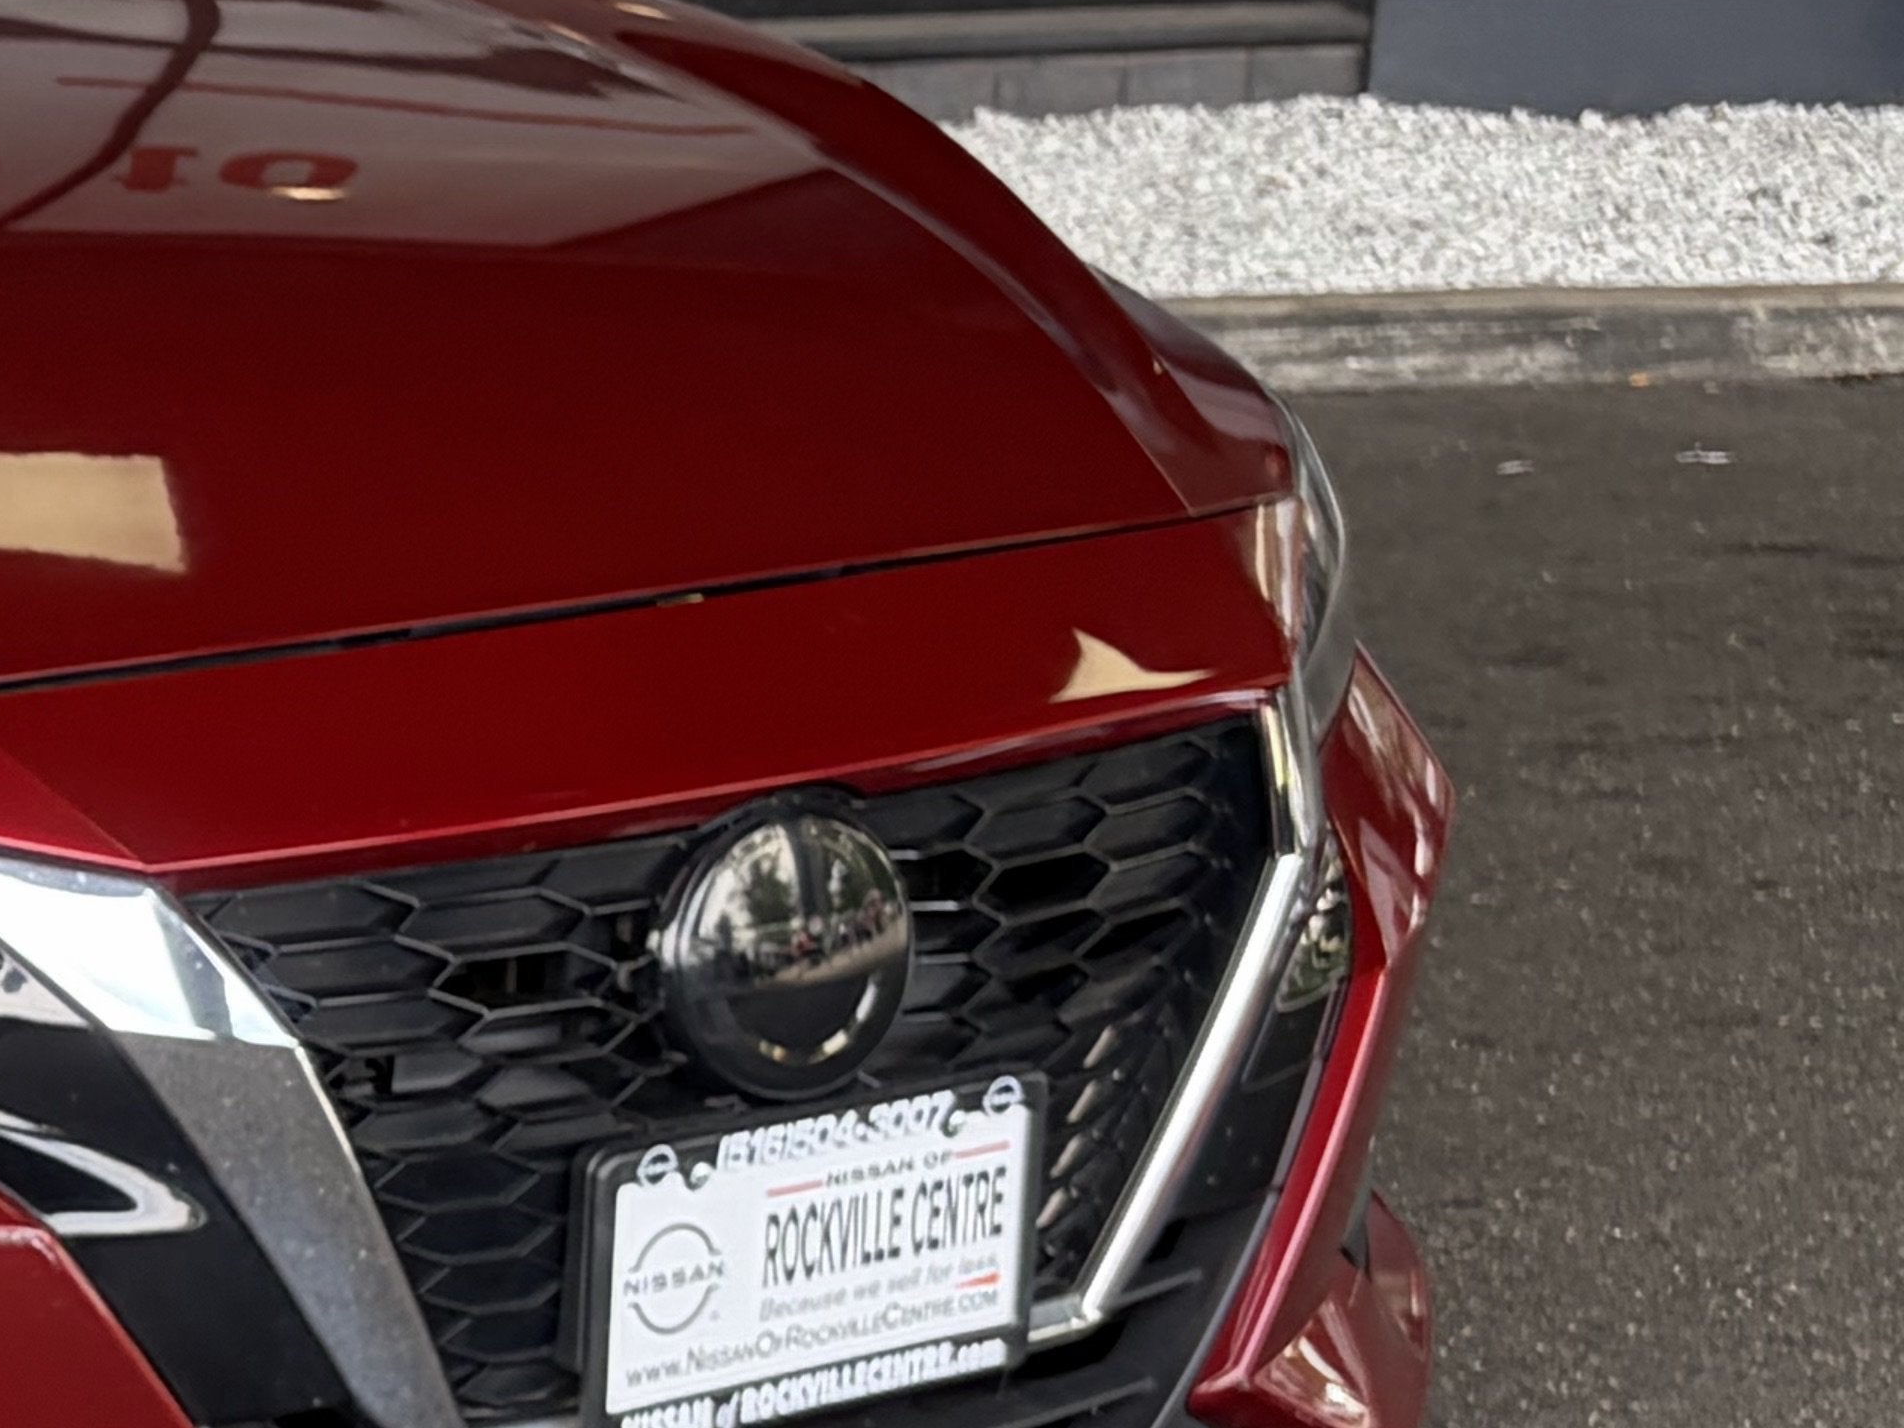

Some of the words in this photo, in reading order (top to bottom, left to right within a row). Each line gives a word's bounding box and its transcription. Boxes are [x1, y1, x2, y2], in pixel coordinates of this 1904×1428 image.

[825, 1151, 916, 1188] NISSAN
[763, 1186, 904, 1289] ROCKVILLE
[911, 1166, 1007, 1254] CENTRE
[623, 1260, 725, 1297] NISSAN
